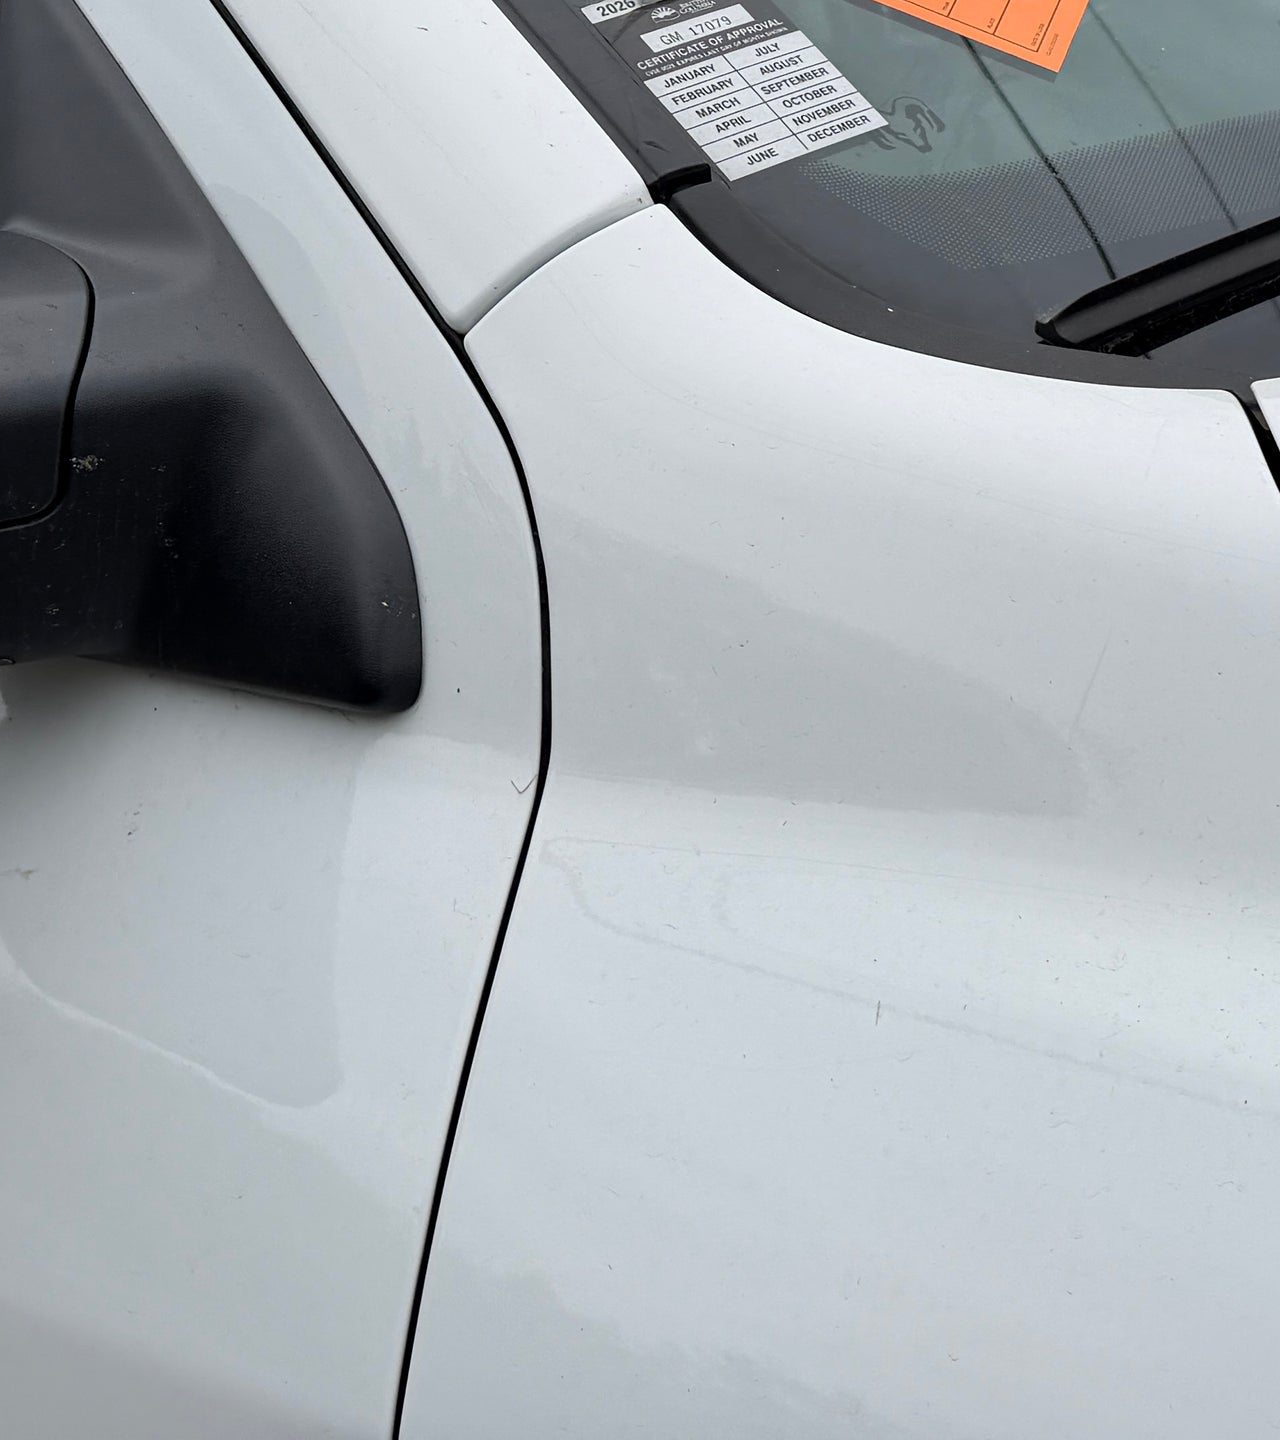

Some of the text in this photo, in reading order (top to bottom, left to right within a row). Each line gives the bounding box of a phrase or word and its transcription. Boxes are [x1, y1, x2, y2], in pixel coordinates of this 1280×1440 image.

[660, 15, 733, 46] GM 17079
[636, 17, 784, 70] CERTIFICATE OF APPROVAL
[754, 42, 781, 58] JULY
[664, 63, 716, 89] JANUARY
[759, 54, 804, 76] AUGUST
[671, 78, 734, 106] FEBRUARY
[760, 67, 830, 95] SEPTEMBER
[695, 97, 741, 119] MARCH
[782, 84, 838, 109] OCTOBER
[715, 115, 752, 134] APRIL
[792, 99, 856, 127] NOVEMBER
[733, 132, 759, 148] MAY
[807, 114, 870, 143] DECEMBER
[746, 148, 779, 166] JUNE
